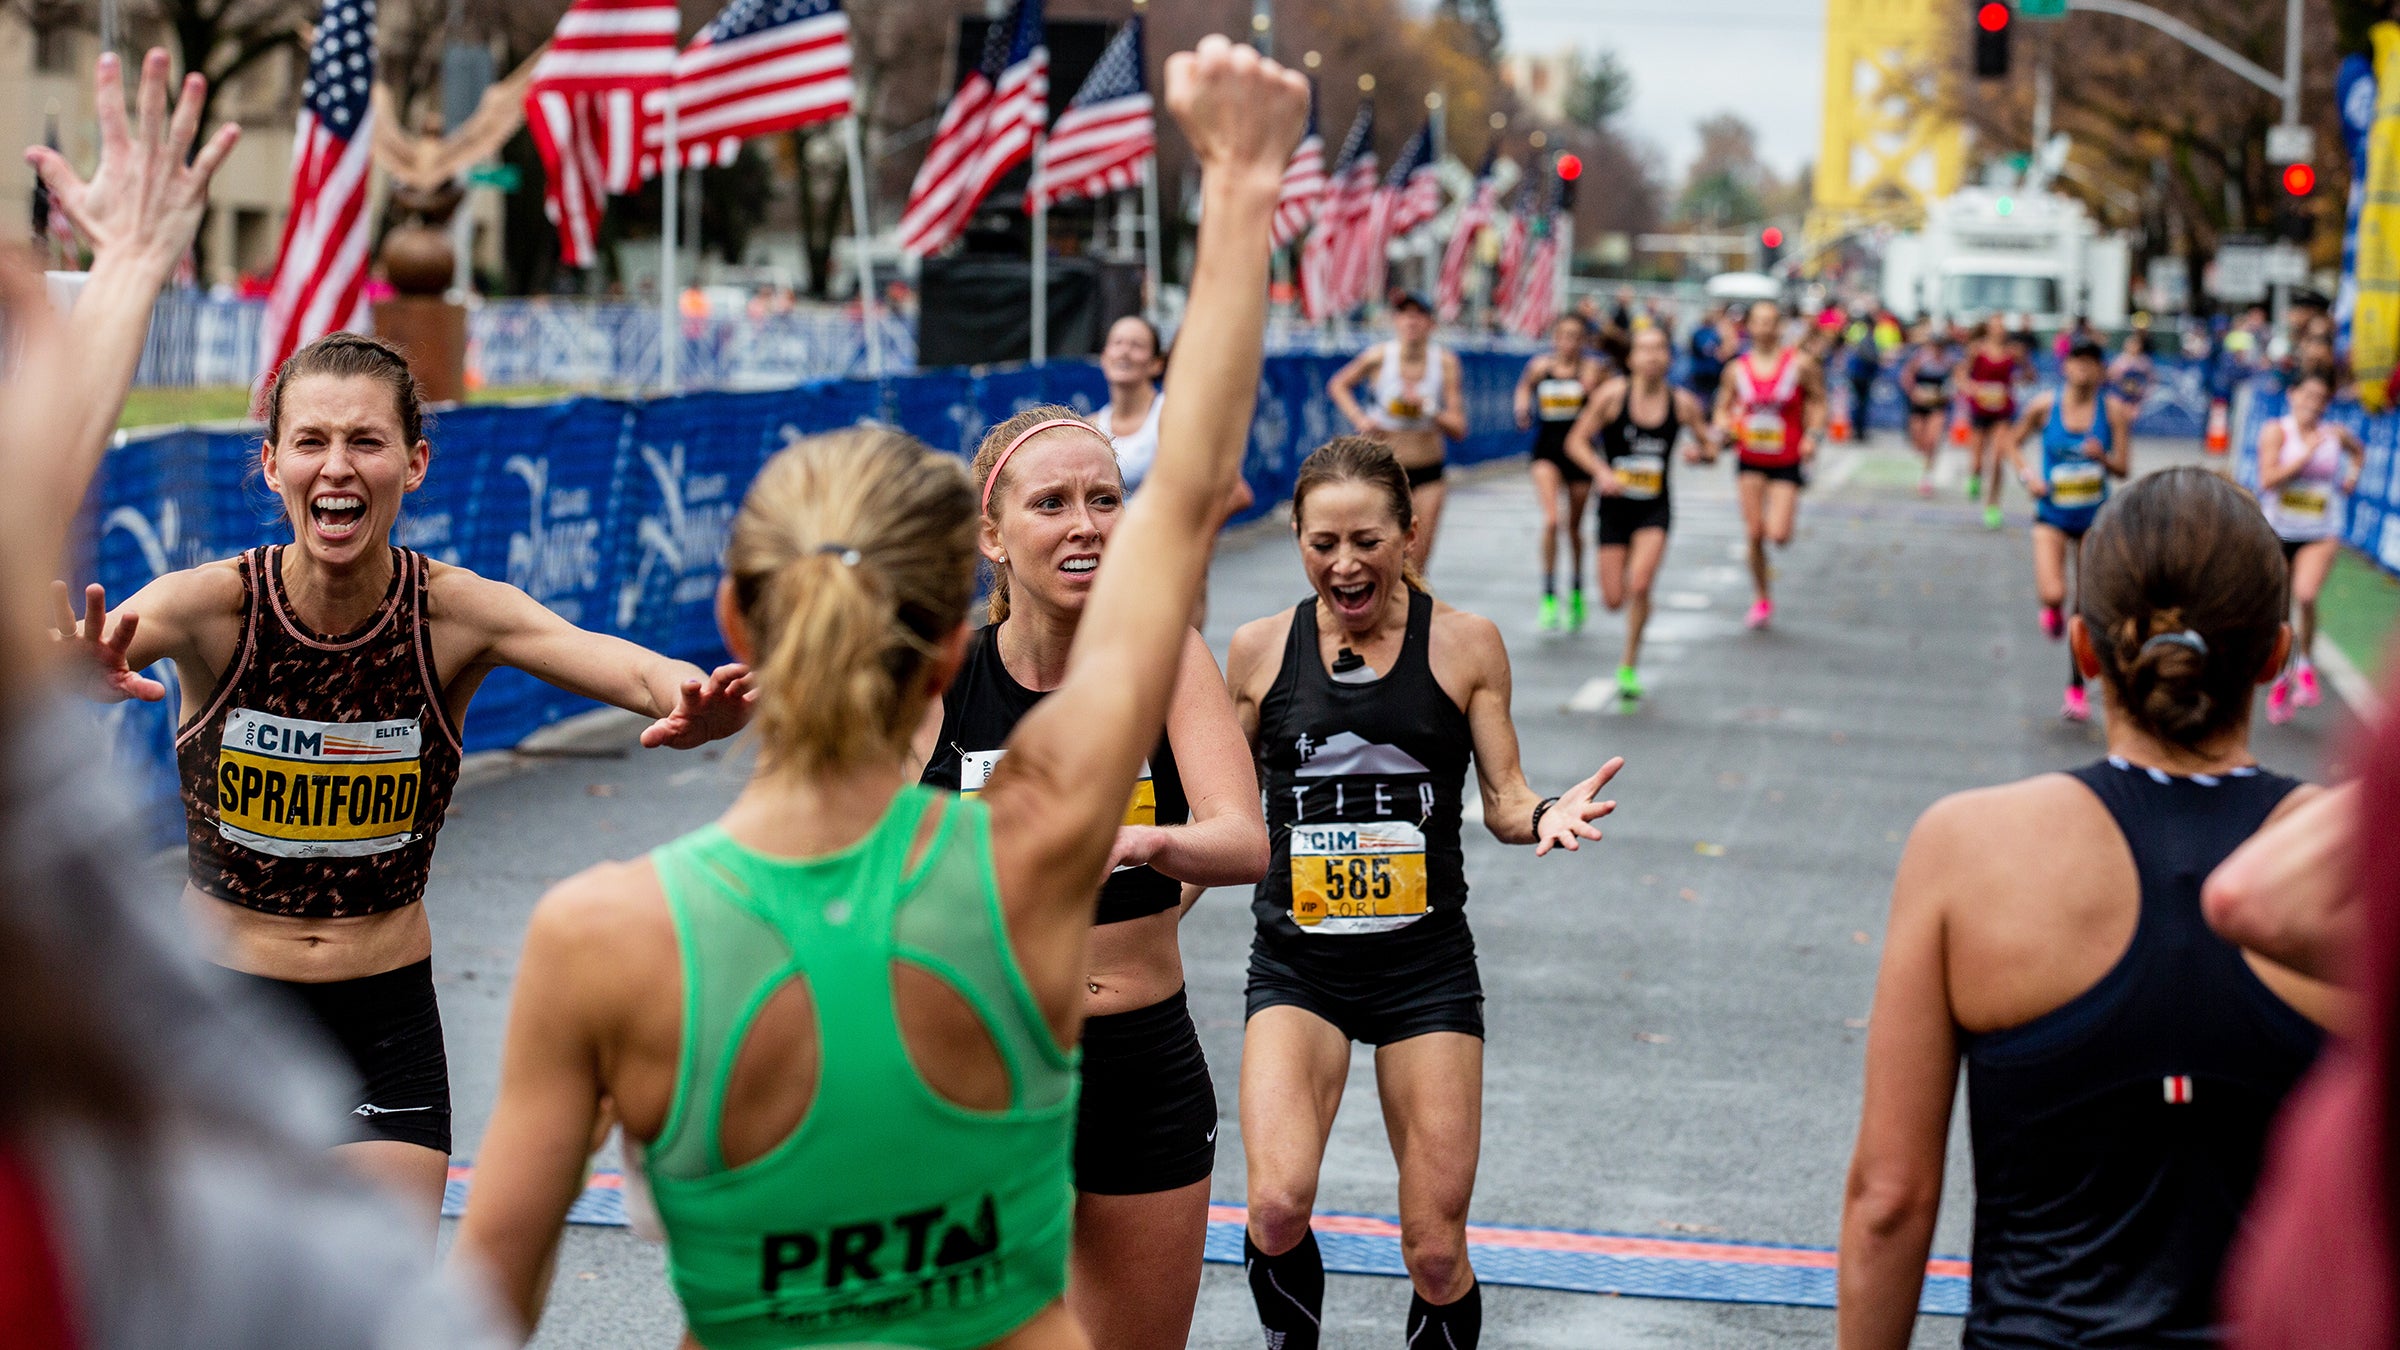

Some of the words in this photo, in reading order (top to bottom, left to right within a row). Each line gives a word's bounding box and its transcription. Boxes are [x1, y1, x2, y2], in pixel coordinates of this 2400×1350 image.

[245, 721, 256, 746] 2019
[256, 723, 323, 757] CIM
[375, 726, 411, 739] ELITE
[219, 761, 418, 827] SPRATFORD
[1291, 781, 1436, 821] TIER
[1311, 831, 1357, 851] CIM
[1325, 857, 1392, 900] 585
[1300, 901, 1318, 913] VIP
[761, 1204, 947, 1293] PRT
